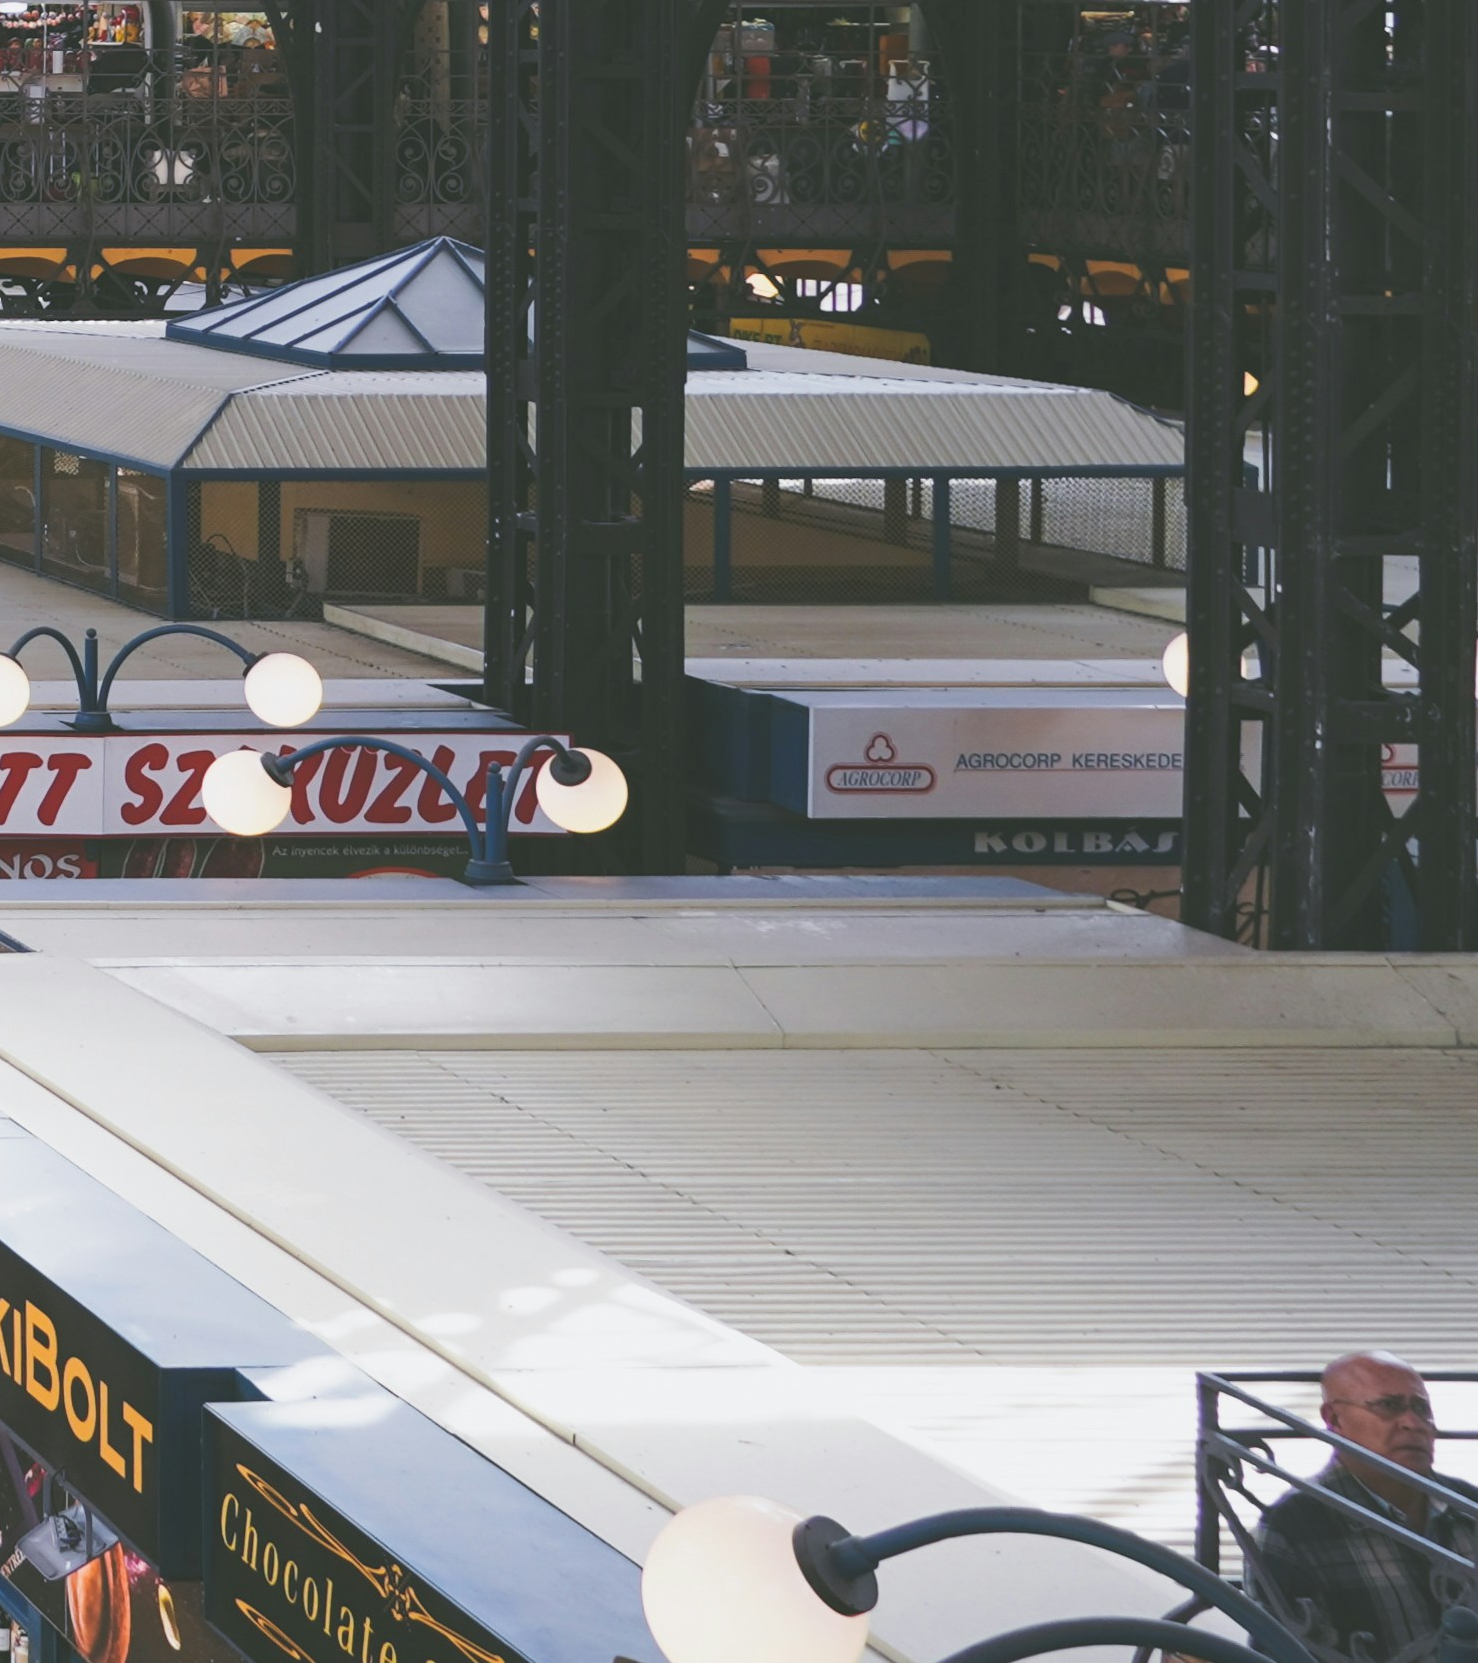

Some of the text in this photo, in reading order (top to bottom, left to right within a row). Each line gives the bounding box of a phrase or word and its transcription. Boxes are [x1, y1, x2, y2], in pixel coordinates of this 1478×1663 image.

[956, 752, 1062, 769] AGROCORP
[120, 739, 558, 827] SZKÜZLET
[836, 769, 921, 788] AGROCORP
[272, 846, 288, 856] Az
[343, 844, 381, 856] élvezik
[219, 1492, 400, 1663] Chocolate
